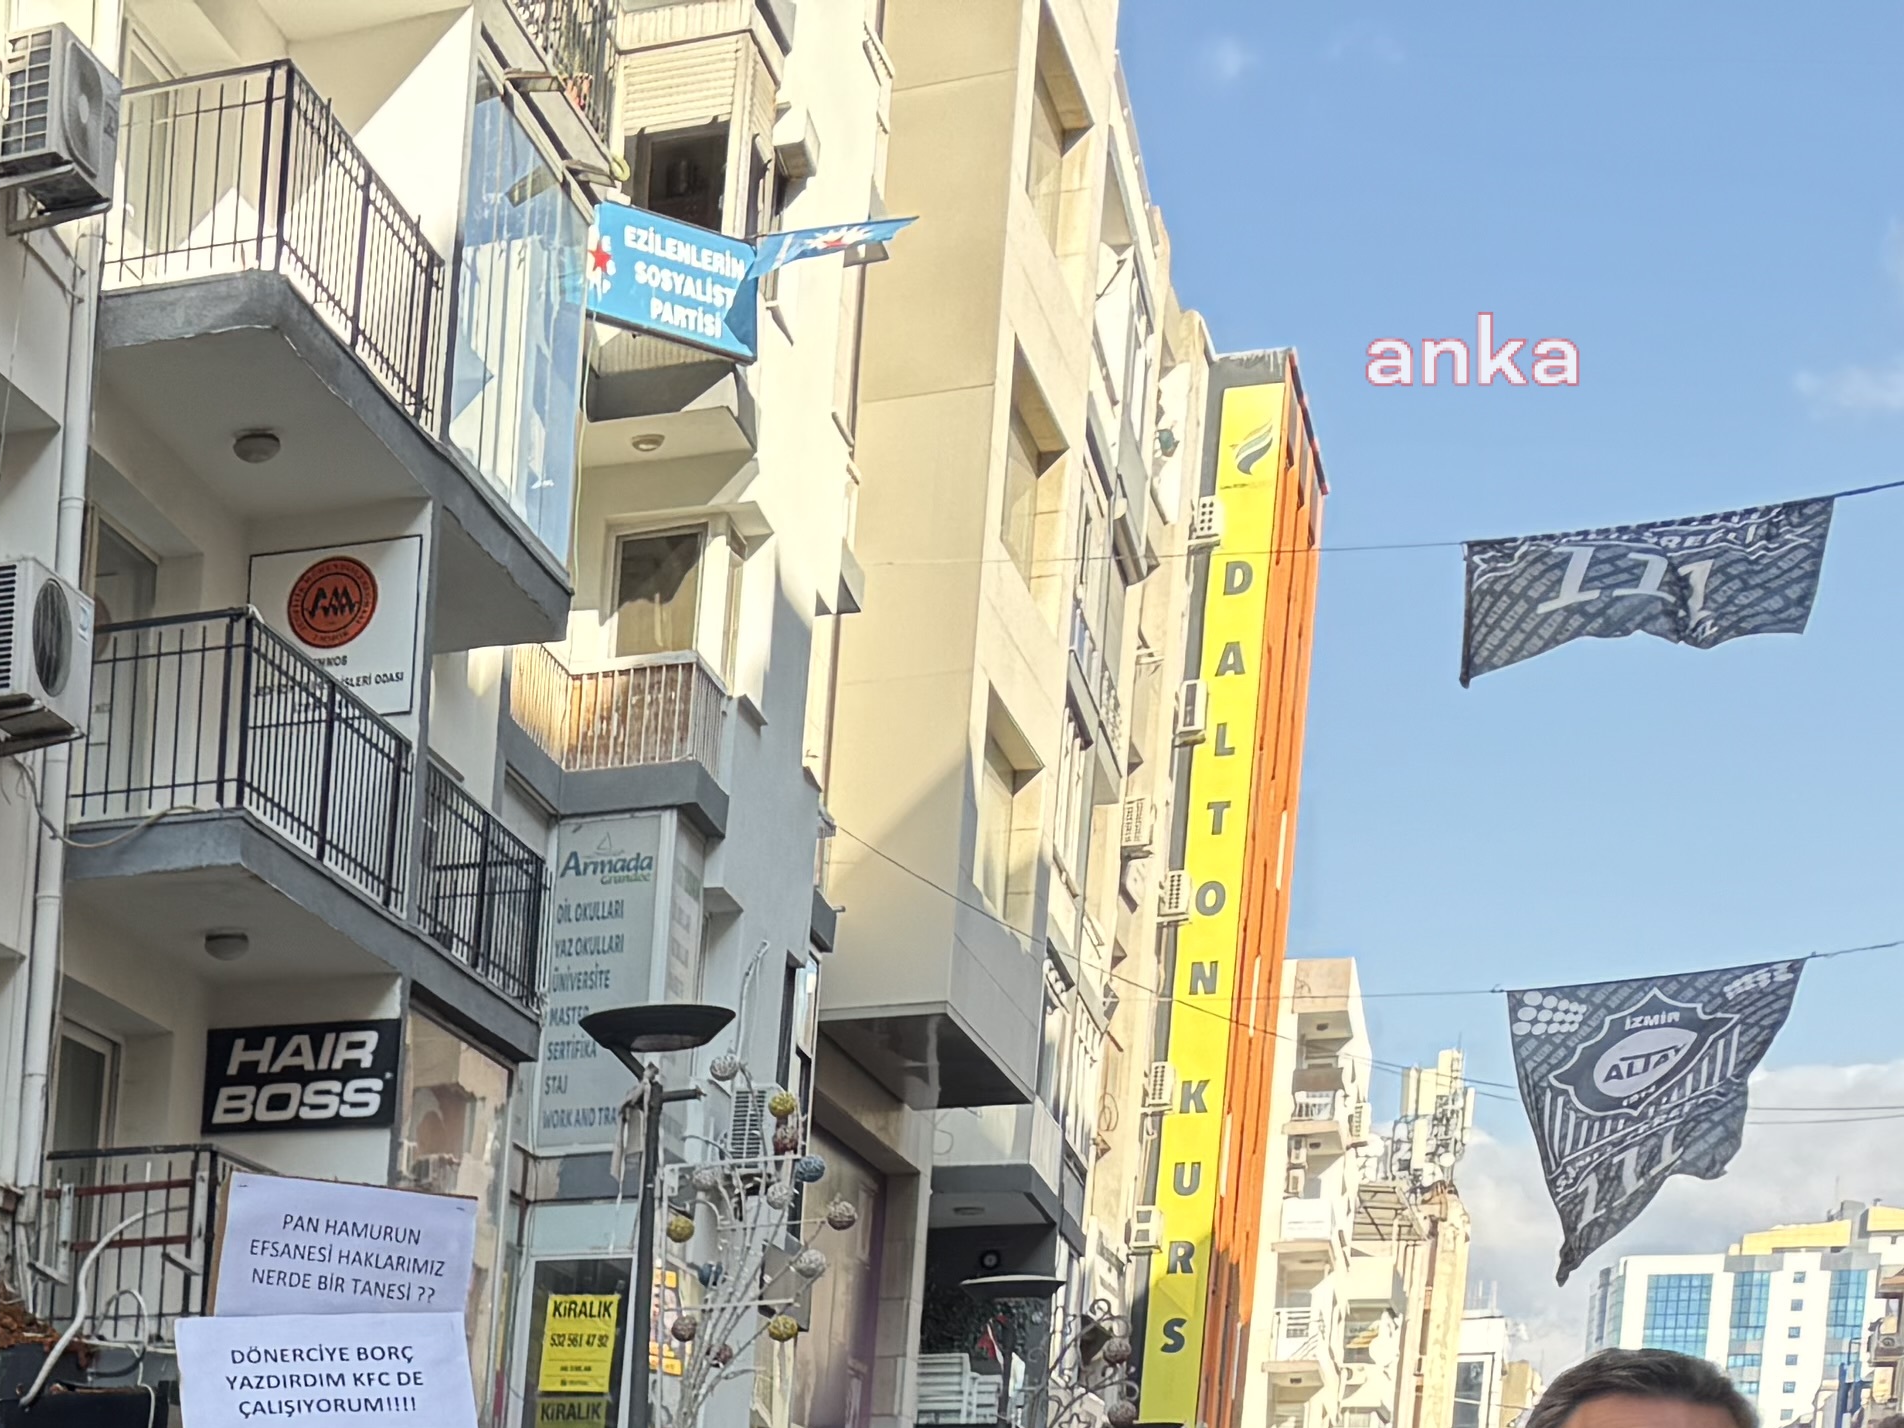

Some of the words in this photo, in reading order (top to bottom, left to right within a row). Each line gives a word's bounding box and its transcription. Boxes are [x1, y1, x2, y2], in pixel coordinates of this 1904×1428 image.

[624, 225, 744, 280] EZİLENLERİN
[634, 260, 736, 310] SOSYALİST
[650, 297, 722, 339] PARTİSİ
[1189, 560, 1254, 996] DALTON
[560, 850, 654, 879] Armada
[556, 898, 573, 925] DİL
[574, 900, 624, 922] OKULLARI
[554, 937, 574, 959] YAZ
[575, 934, 625, 956] OKULLARI
[552, 963, 611, 993] ÜNİVERSİTE
[225, 1028, 380, 1076] HAIR
[210, 1077, 385, 1125] BOSS
[544, 1074, 569, 1095] STAJ
[542, 1107, 572, 1129] WORK
[573, 1106, 596, 1128] AND
[281, 1212, 318, 1236] PAN
[324, 1217, 422, 1246] HAMURUN
[1160, 1078, 1209, 1354] KURS
[248, 1237, 334, 1266] EFSANESİ
[336, 1247, 447, 1279] HAKLARIMIZ
[251, 1266, 312, 1291] NERDE
[316, 1270, 347, 1294] BİR
[350, 1276, 412, 1302] TANESİ
[229, 1341, 350, 1365] DÖNERCİYE
[356, 1343, 414, 1368] BORÇ
[225, 1370, 347, 1391] YAZDIRDIM
[351, 1369, 392, 1389] KFC
[396, 1368, 425, 1388] DE
[237, 1394, 418, 1421] ÇALIŞIYORUM!!!!
